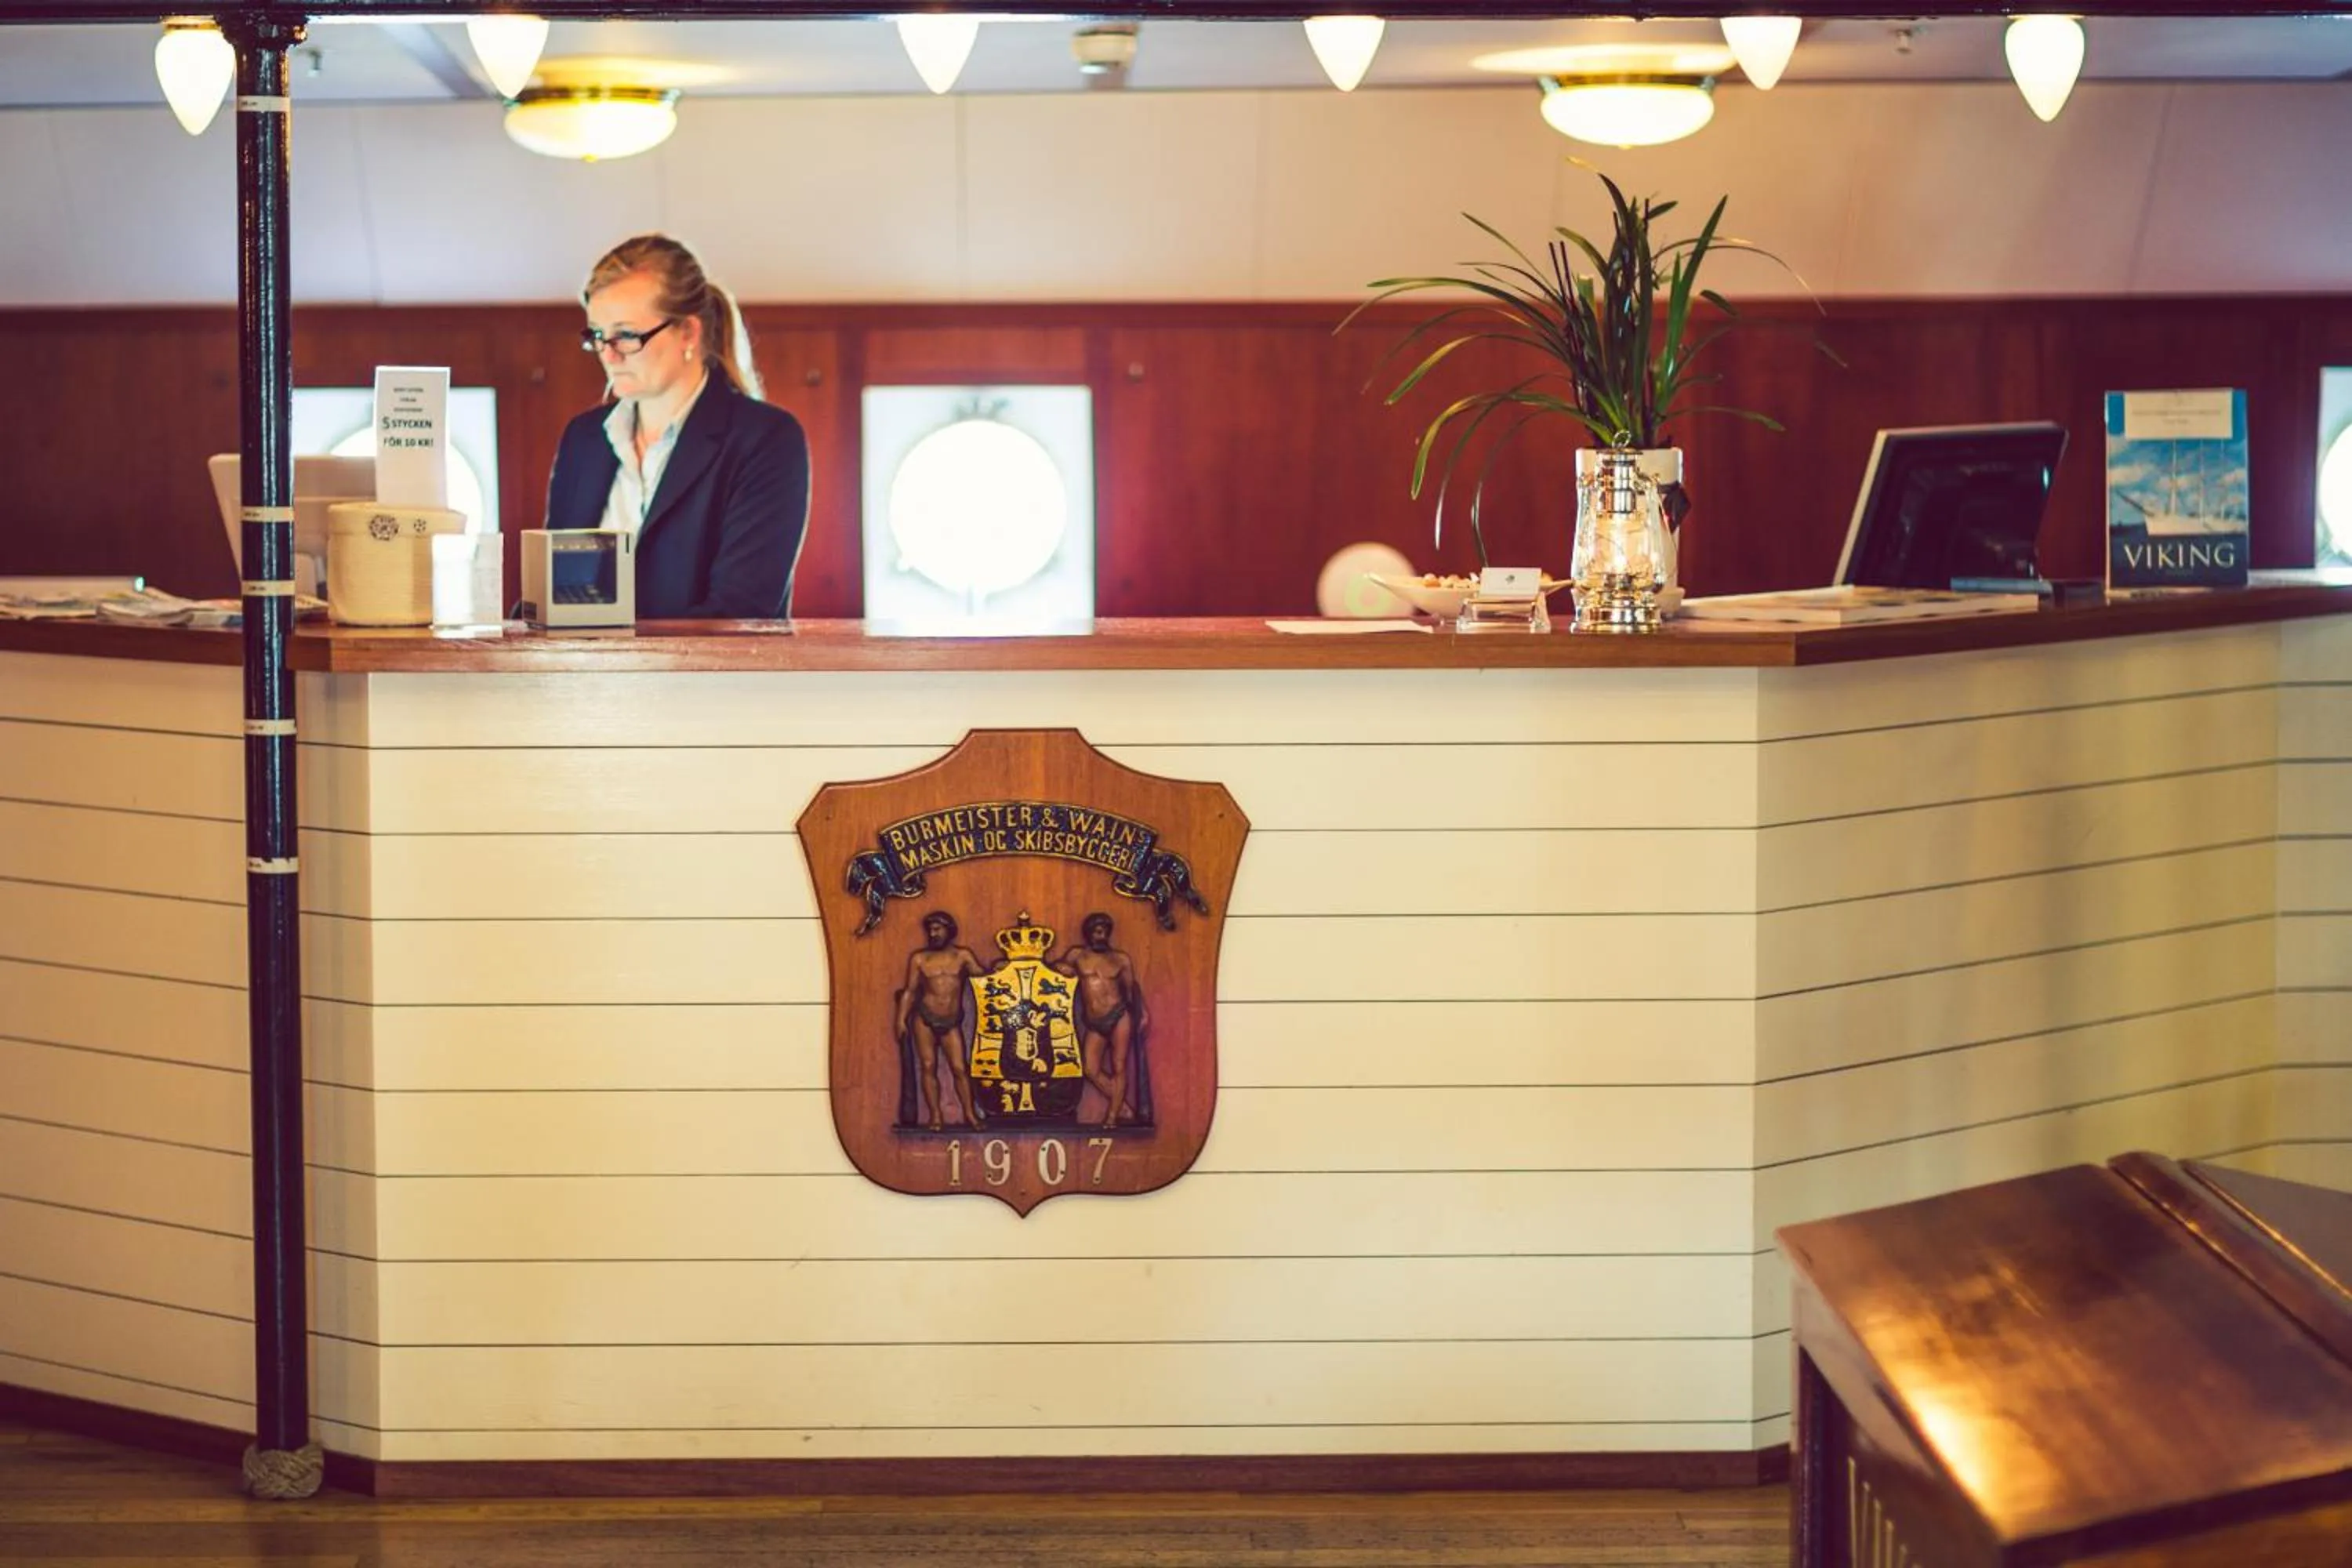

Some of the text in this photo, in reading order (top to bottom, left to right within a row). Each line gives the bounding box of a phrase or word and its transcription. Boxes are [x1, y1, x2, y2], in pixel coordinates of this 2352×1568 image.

[382, 416, 433, 429] 5 STYCKEN
[383, 436, 402, 447] FÖR
[2124, 543, 2234, 568] VIKING
[890, 806, 1146, 851] BURMEISTER & WAINS
[899, 833, 976, 871] MASKIN
[946, 1137, 1113, 1186] 1907
